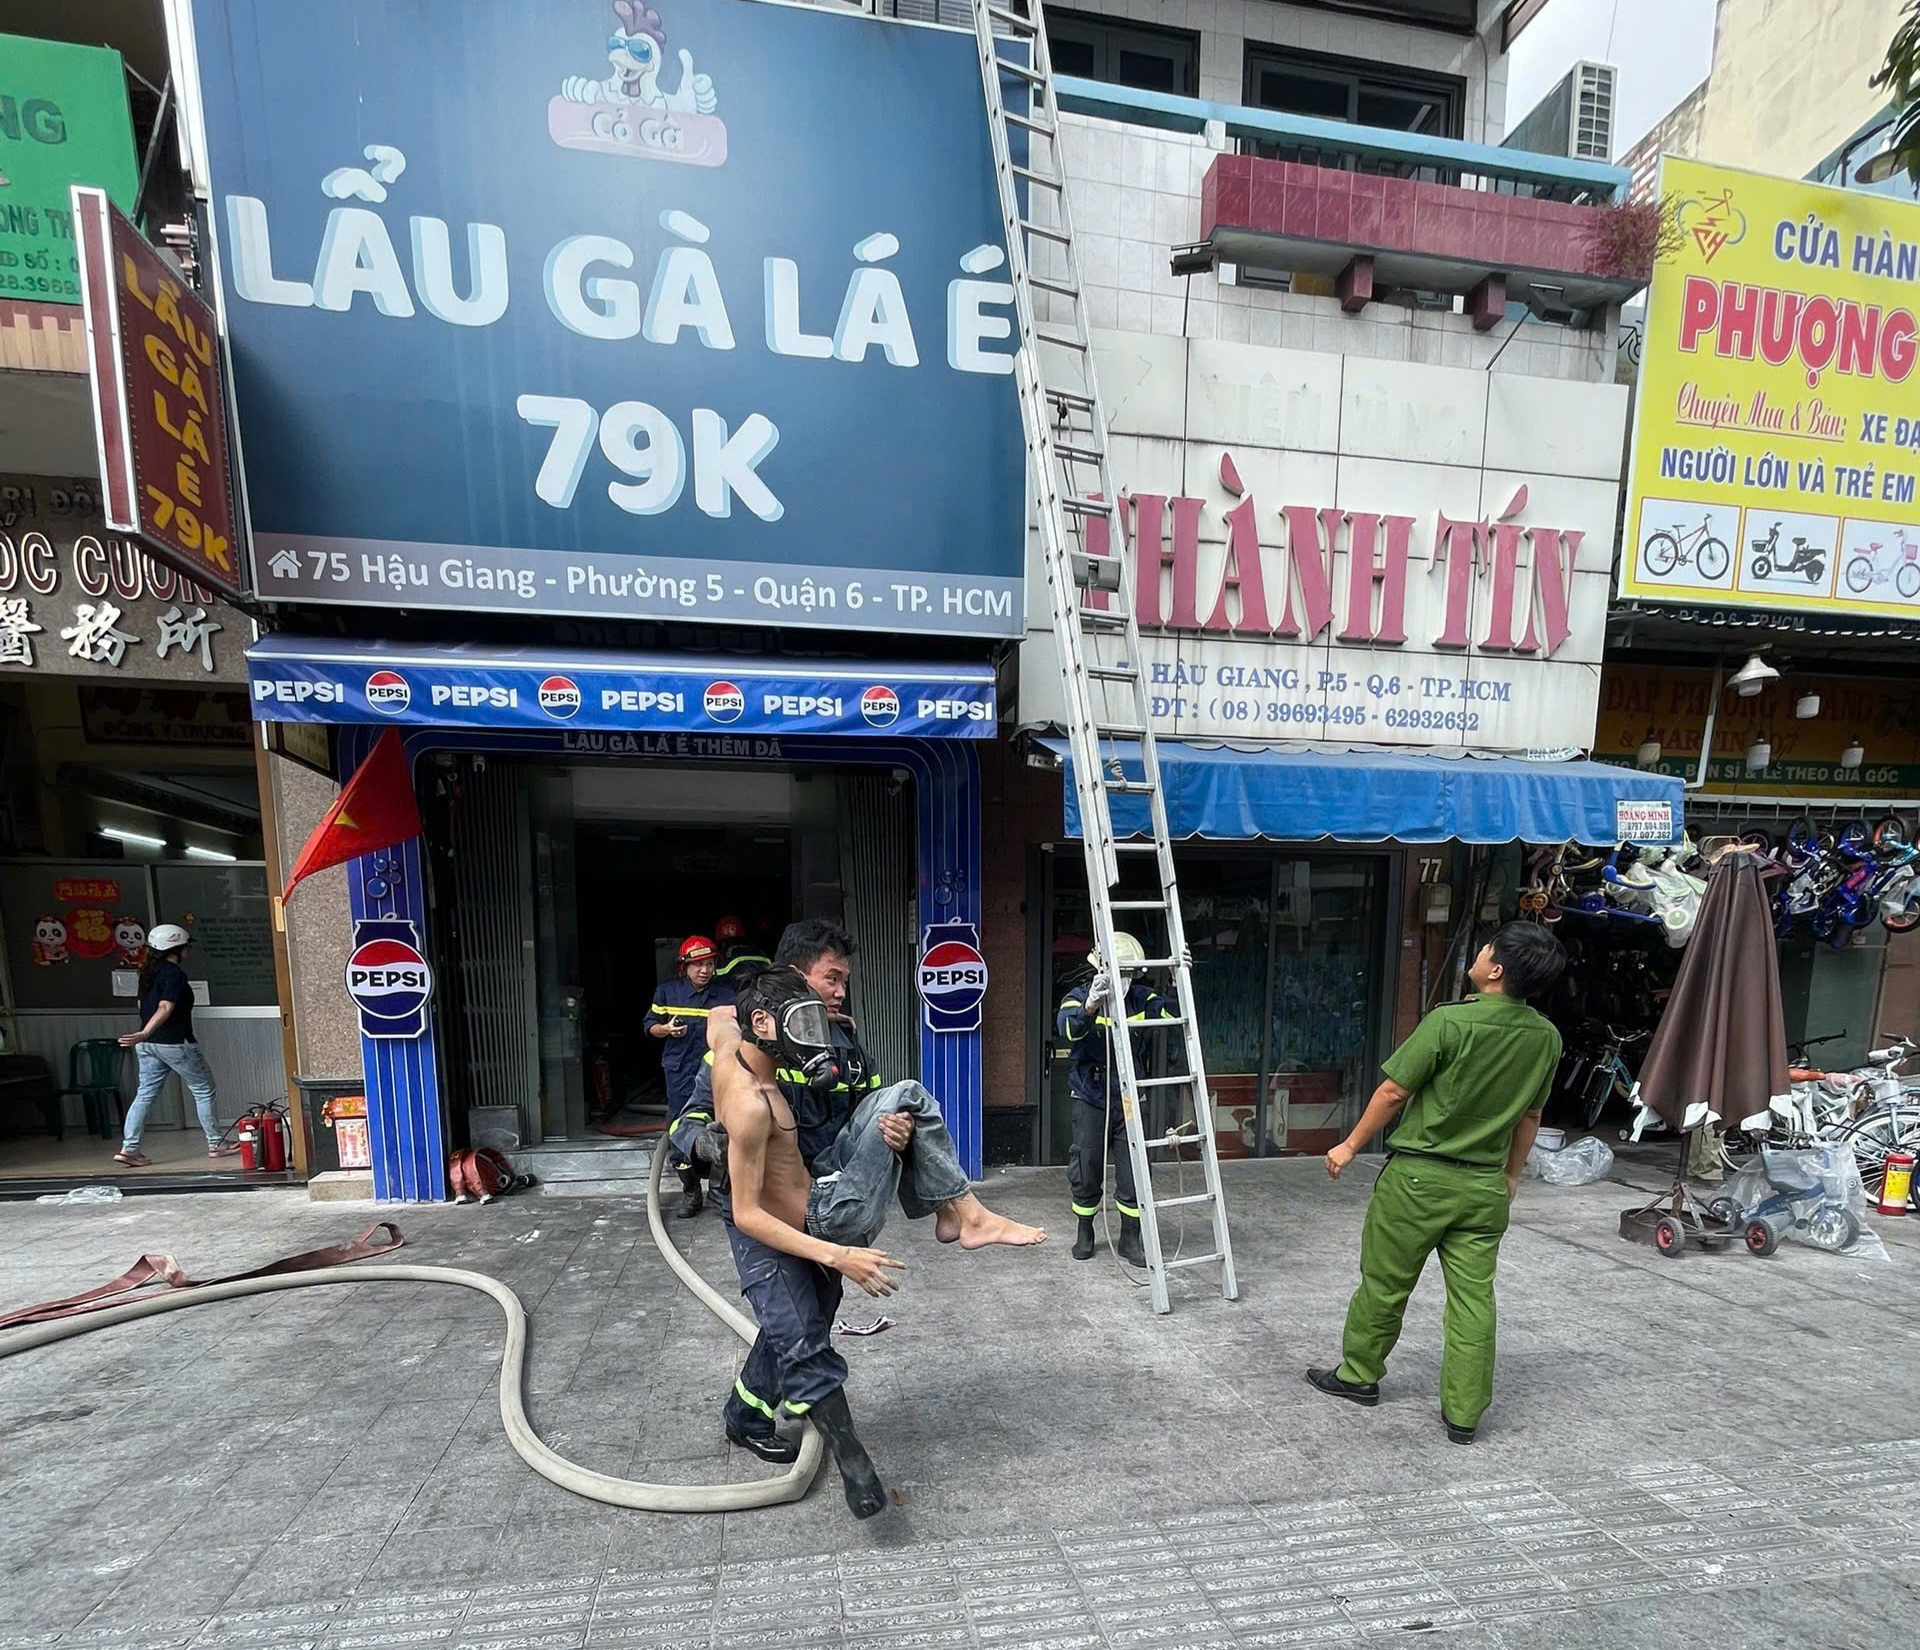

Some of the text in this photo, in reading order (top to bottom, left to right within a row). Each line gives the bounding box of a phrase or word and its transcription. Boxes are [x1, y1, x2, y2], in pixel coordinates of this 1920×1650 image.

[225, 144, 1016, 376] LẨU GÀ LÁ É
[1775, 214, 1920, 282] CỬA HÀN
[1678, 274, 1919, 389] PHƯỢNG
[144, 334, 209, 416] GÀ
[1677, 381, 1741, 430] Chuyên
[1744, 390, 1785, 431] Mua
[1789, 401, 1801, 432] &
[1860, 413, 1888, 444] XE
[516, 394, 785, 523] 79K
[1661, 446, 1916, 504] NGƯỜI LỚN VÀ TRẺ EM
[146, 484, 231, 572] 79K
[307, 551, 351, 582] 75
[361, 554, 429, 592] Hậu
[439, 559, 537, 599] Giang
[566, 566, 697, 607] Phường
[706, 574, 724, 601] 5
[754, 576, 836, 612] Quận
[846, 582, 864, 610] 6
[891, 584, 933, 613] TP.
[942, 587, 1013, 617] HCM
[1428, 484, 1586, 660] TÍN
[253, 679, 993, 721] PEPSI PEPSI PEPSI PEPSI PEPSI PEPSI PEPSI PEPSI PEPSI
[1151, 658, 1207, 690] HẬU
[1317, 671, 1347, 693] P.5
[1366, 674, 1400, 699] Q.6
[1421, 677, 1512, 702] TP.HCM
[1266, 702, 1366, 726] 39693495
[1384, 708, 1480, 731] 62932632
[1786, 766, 1829, 781] THEO
[1419, 858, 1442, 883] 77
[351, 970, 426, 990] PEPSI
[922, 969, 984, 987] PEPSI
